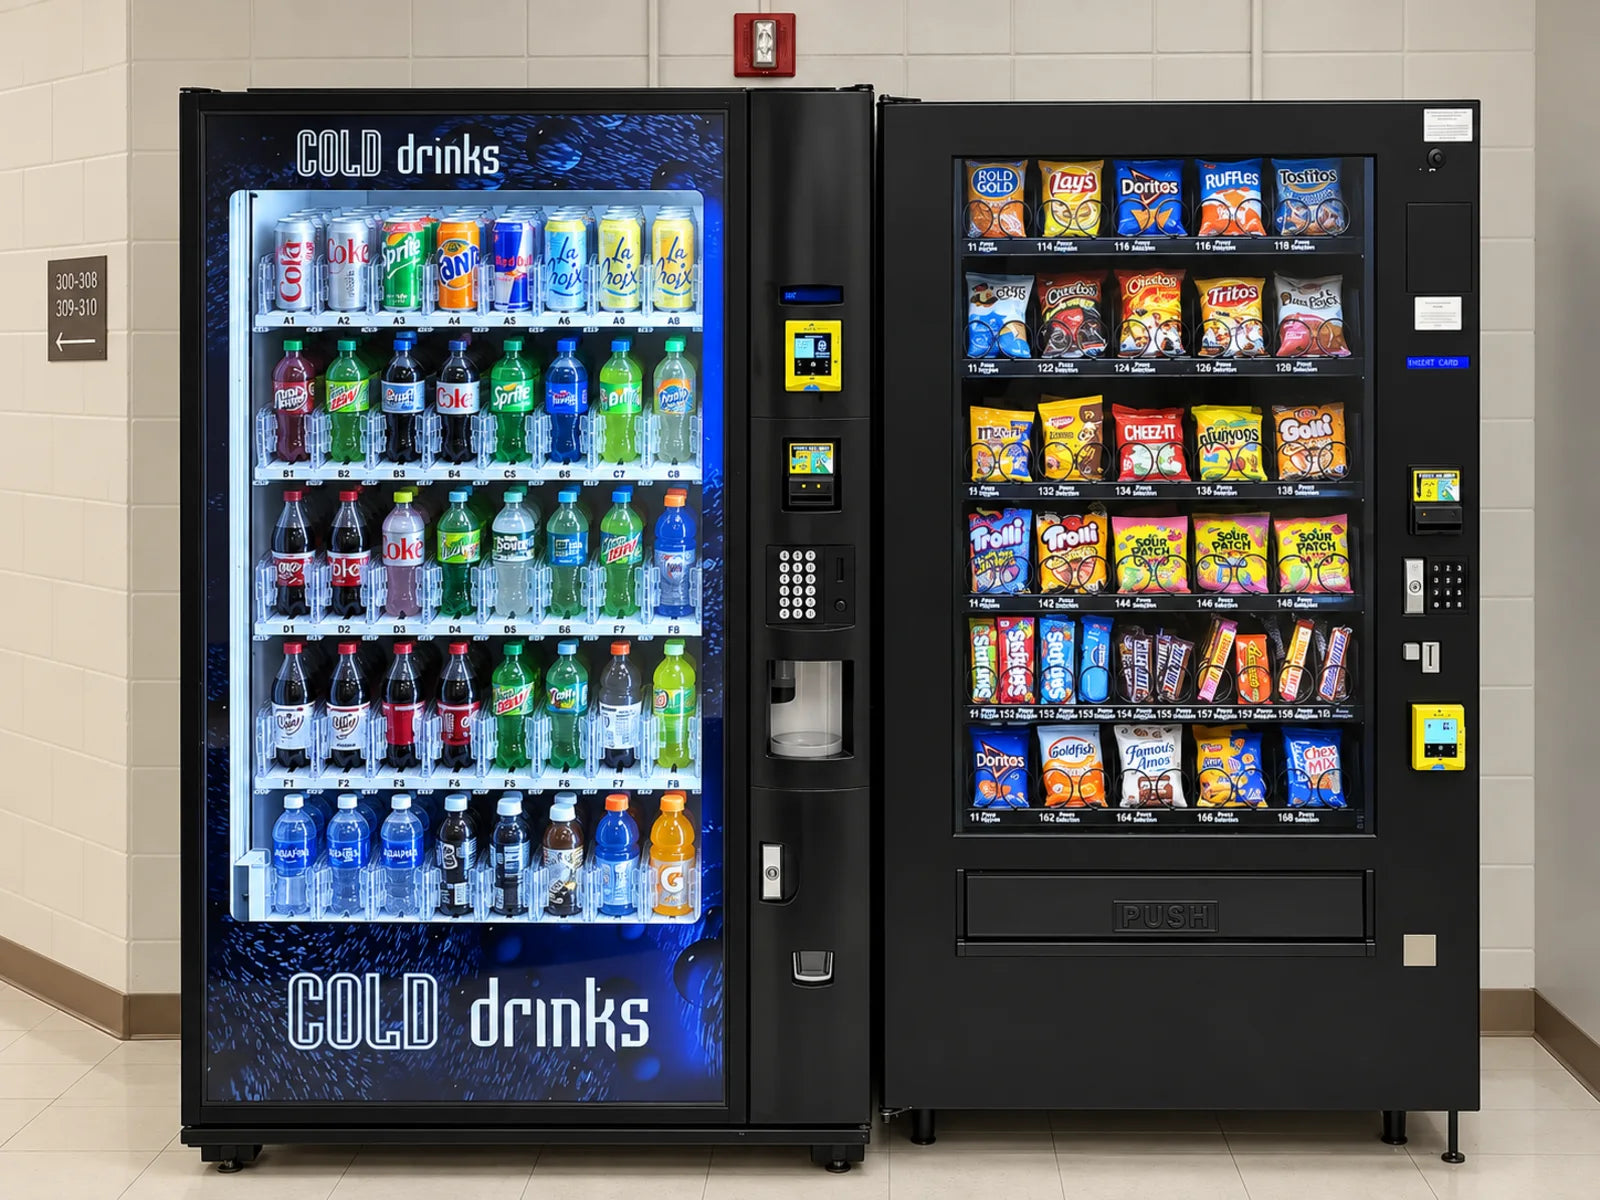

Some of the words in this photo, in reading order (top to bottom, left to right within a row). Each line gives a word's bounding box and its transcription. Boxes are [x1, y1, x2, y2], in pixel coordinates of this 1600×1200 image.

[297, 129, 381, 177] COLD
[397, 133, 499, 176] drinks
[1279, 168, 1338, 185] Tostitos
[977, 181, 1013, 194] GOLD
[1121, 179, 1179, 195] Doritos
[327, 237, 370, 265] Coke
[558, 236, 579, 264] La
[612, 236, 635, 264] La
[666, 236, 689, 264] La
[1114, 241, 1130, 251] 116
[1195, 241, 1212, 251] 116
[56, 271, 98, 291] 300-308
[56, 297, 98, 317] 309-310
[283, 316, 295, 325] A1
[337, 316, 350, 325] A2
[392, 316, 405, 325] A3
[447, 316, 461, 325] A4
[558, 316, 571, 325] A6
[1037, 363, 1054, 373] 122
[1114, 363, 1130, 373] 124
[493, 384, 531, 410] Sprite
[1124, 424, 1176, 441] CHEEZ-IT
[392, 469, 405, 478] B3
[612, 469, 625, 478] C7
[1038, 486, 1055, 496] 132
[970, 517, 1023, 552] Trolli
[1042, 522, 1099, 552] Trolli
[1217, 530, 1249, 542] SOUR
[1298, 531, 1333, 543] SOUR
[1136, 537, 1167, 547] SOUR
[1211, 541, 1251, 554] PATCH
[1295, 541, 1337, 554] PATCH
[1038, 598, 1055, 609] 142
[1196, 598, 1213, 608] 146
[283, 625, 295, 634] D1
[337, 625, 350, 634] D2
[392, 625, 405, 634] D3
[447, 625, 461, 634] D4
[612, 625, 625, 634] F7
[1051, 743, 1095, 759] Goldfish
[1125, 741, 1175, 766] Famous
[1304, 745, 1337, 761] Chex
[283, 779, 295, 788] F1
[337, 779, 350, 788] F2
[612, 779, 625, 788] F7
[1038, 812, 1055, 823] 162
[1116, 812, 1133, 822] 164
[1122, 905, 1209, 929] PUSH
[288, 972, 438, 1050] COLD
[470, 976, 650, 1052] drinks
